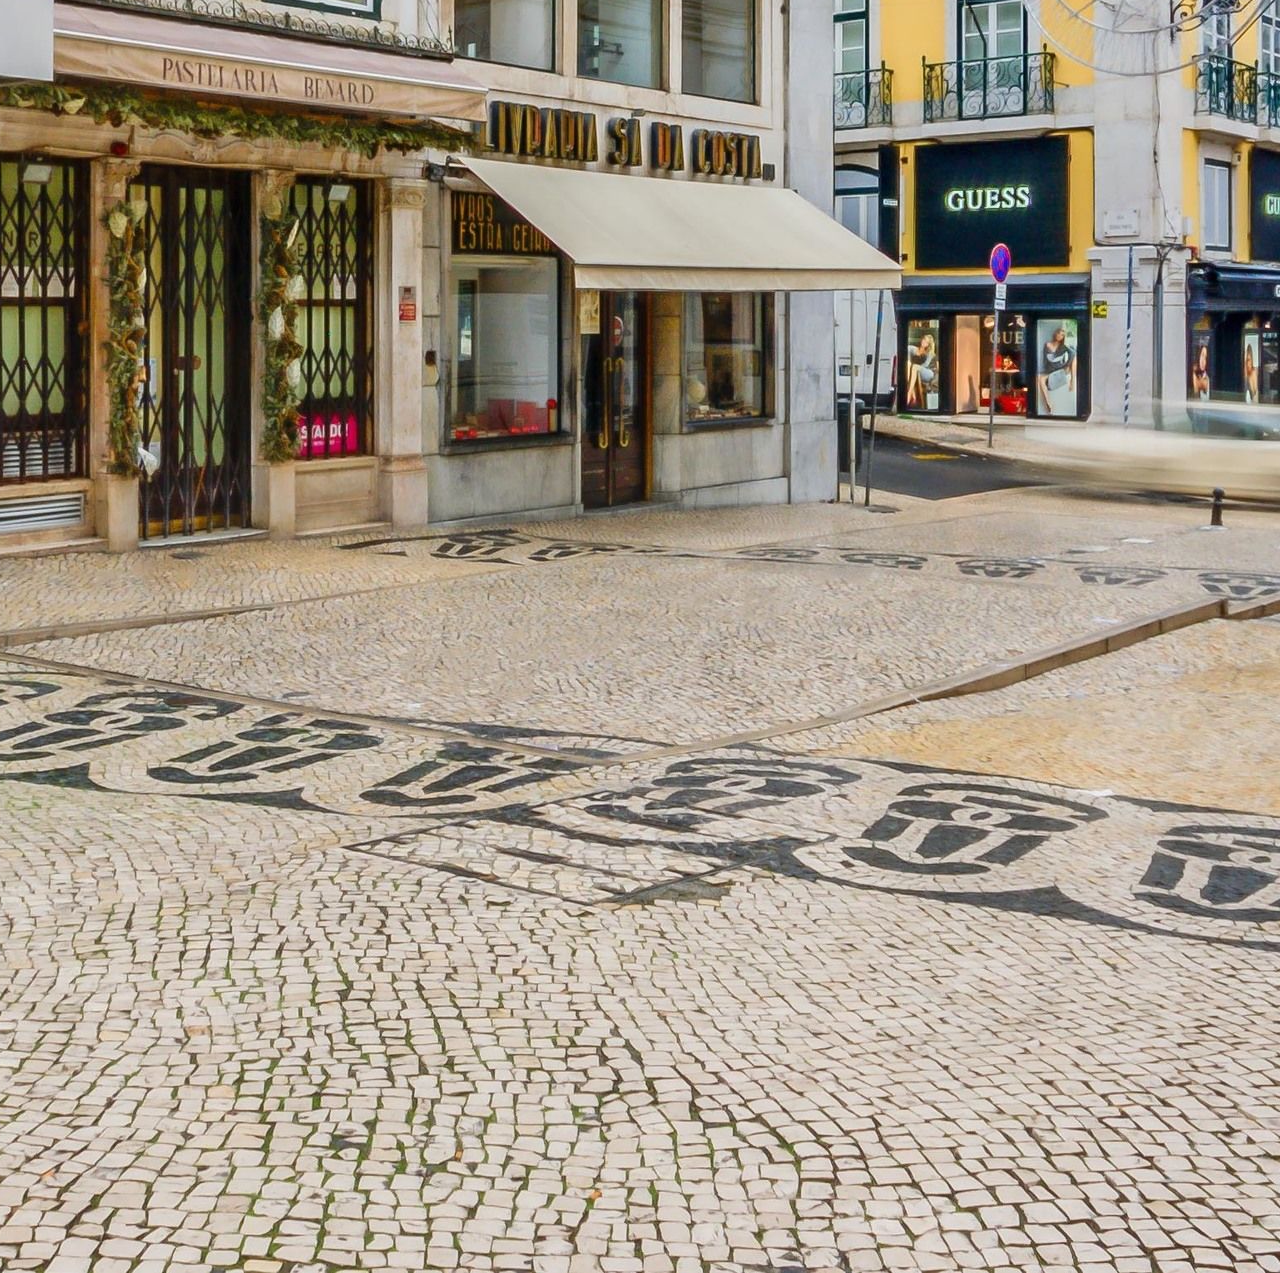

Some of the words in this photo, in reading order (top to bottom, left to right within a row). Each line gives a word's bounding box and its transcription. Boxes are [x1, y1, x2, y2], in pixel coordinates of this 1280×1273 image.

[162, 57, 280, 94] PASTELARIA
[304, 76, 375, 105] BENARD
[692, 128, 762, 178] COSTA
[947, 186, 1030, 211] GUESS
